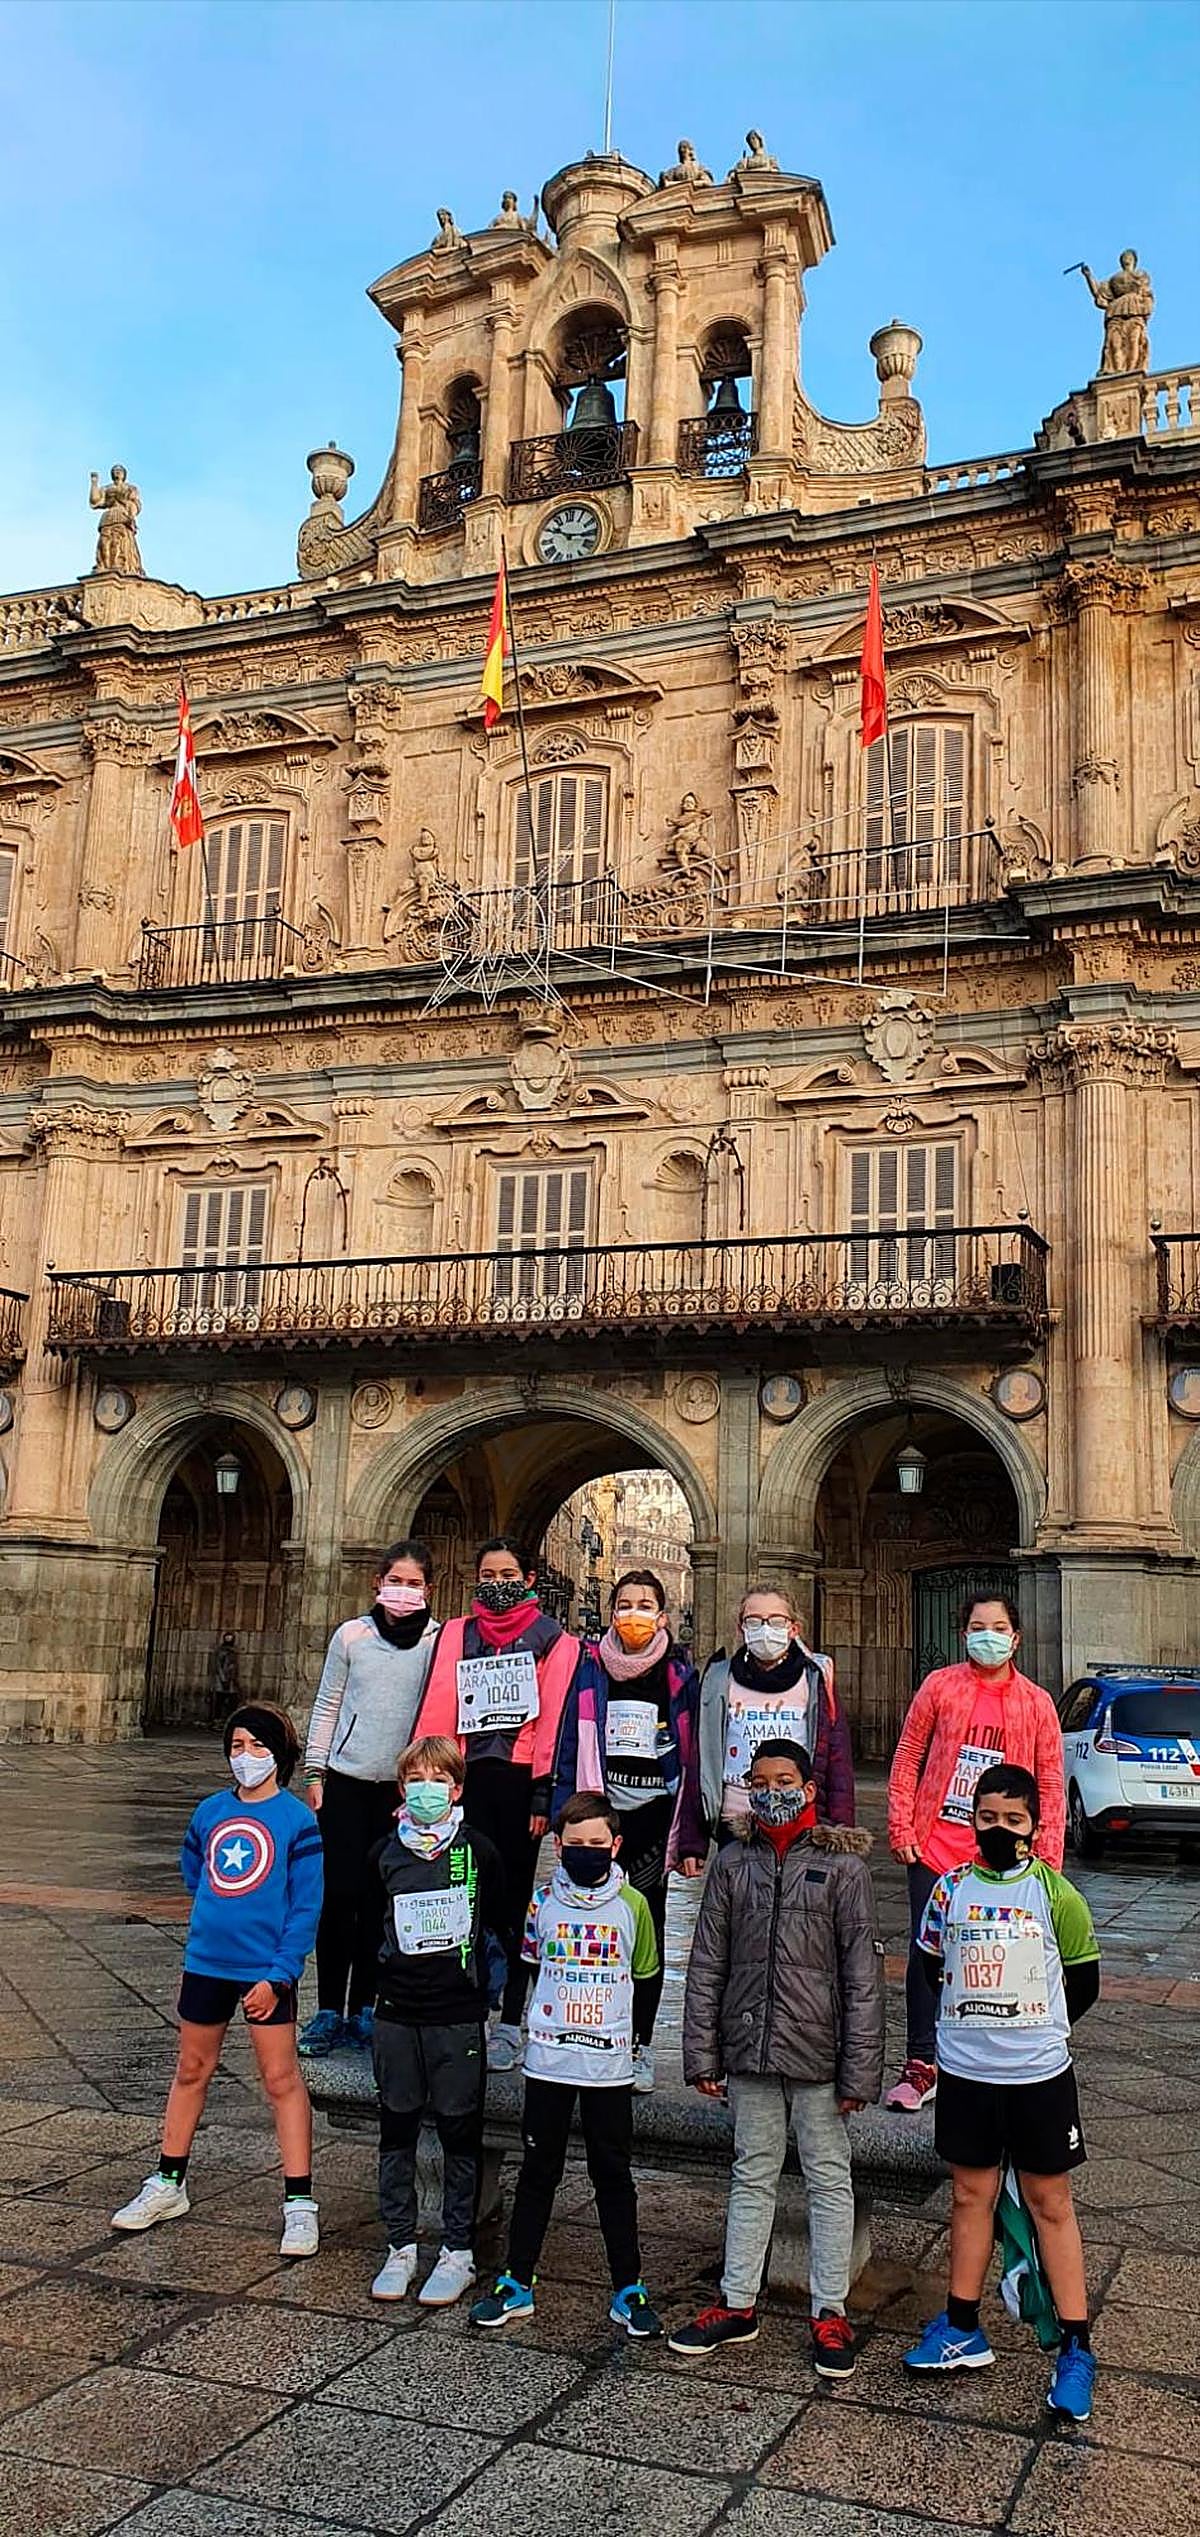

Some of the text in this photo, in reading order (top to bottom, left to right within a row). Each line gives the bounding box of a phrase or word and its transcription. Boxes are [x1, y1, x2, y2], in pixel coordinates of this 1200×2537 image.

[485, 1657, 532, 1671] SETEL
[487, 1684, 519, 1704] 1040
[748, 1710, 801, 1721] SETEL
[742, 1724, 792, 1739] AMAIA
[1075, 1742, 1089, 1760] 112
[1148, 1747, 1181, 1761] 112
[630, 1775, 640, 1786] IT
[450, 1847, 465, 1881] GAME
[419, 1897, 455, 1908] SETEL
[422, 1917, 447, 1933] 1044
[961, 1928, 1021, 1941] SETEL
[960, 1944, 1006, 1963] POLO
[565, 1970, 618, 1984] SETEL
[963, 1963, 1004, 1988] 1037
[557, 1985, 614, 2003] OLIVER
[565, 2002, 604, 2025] 1035
